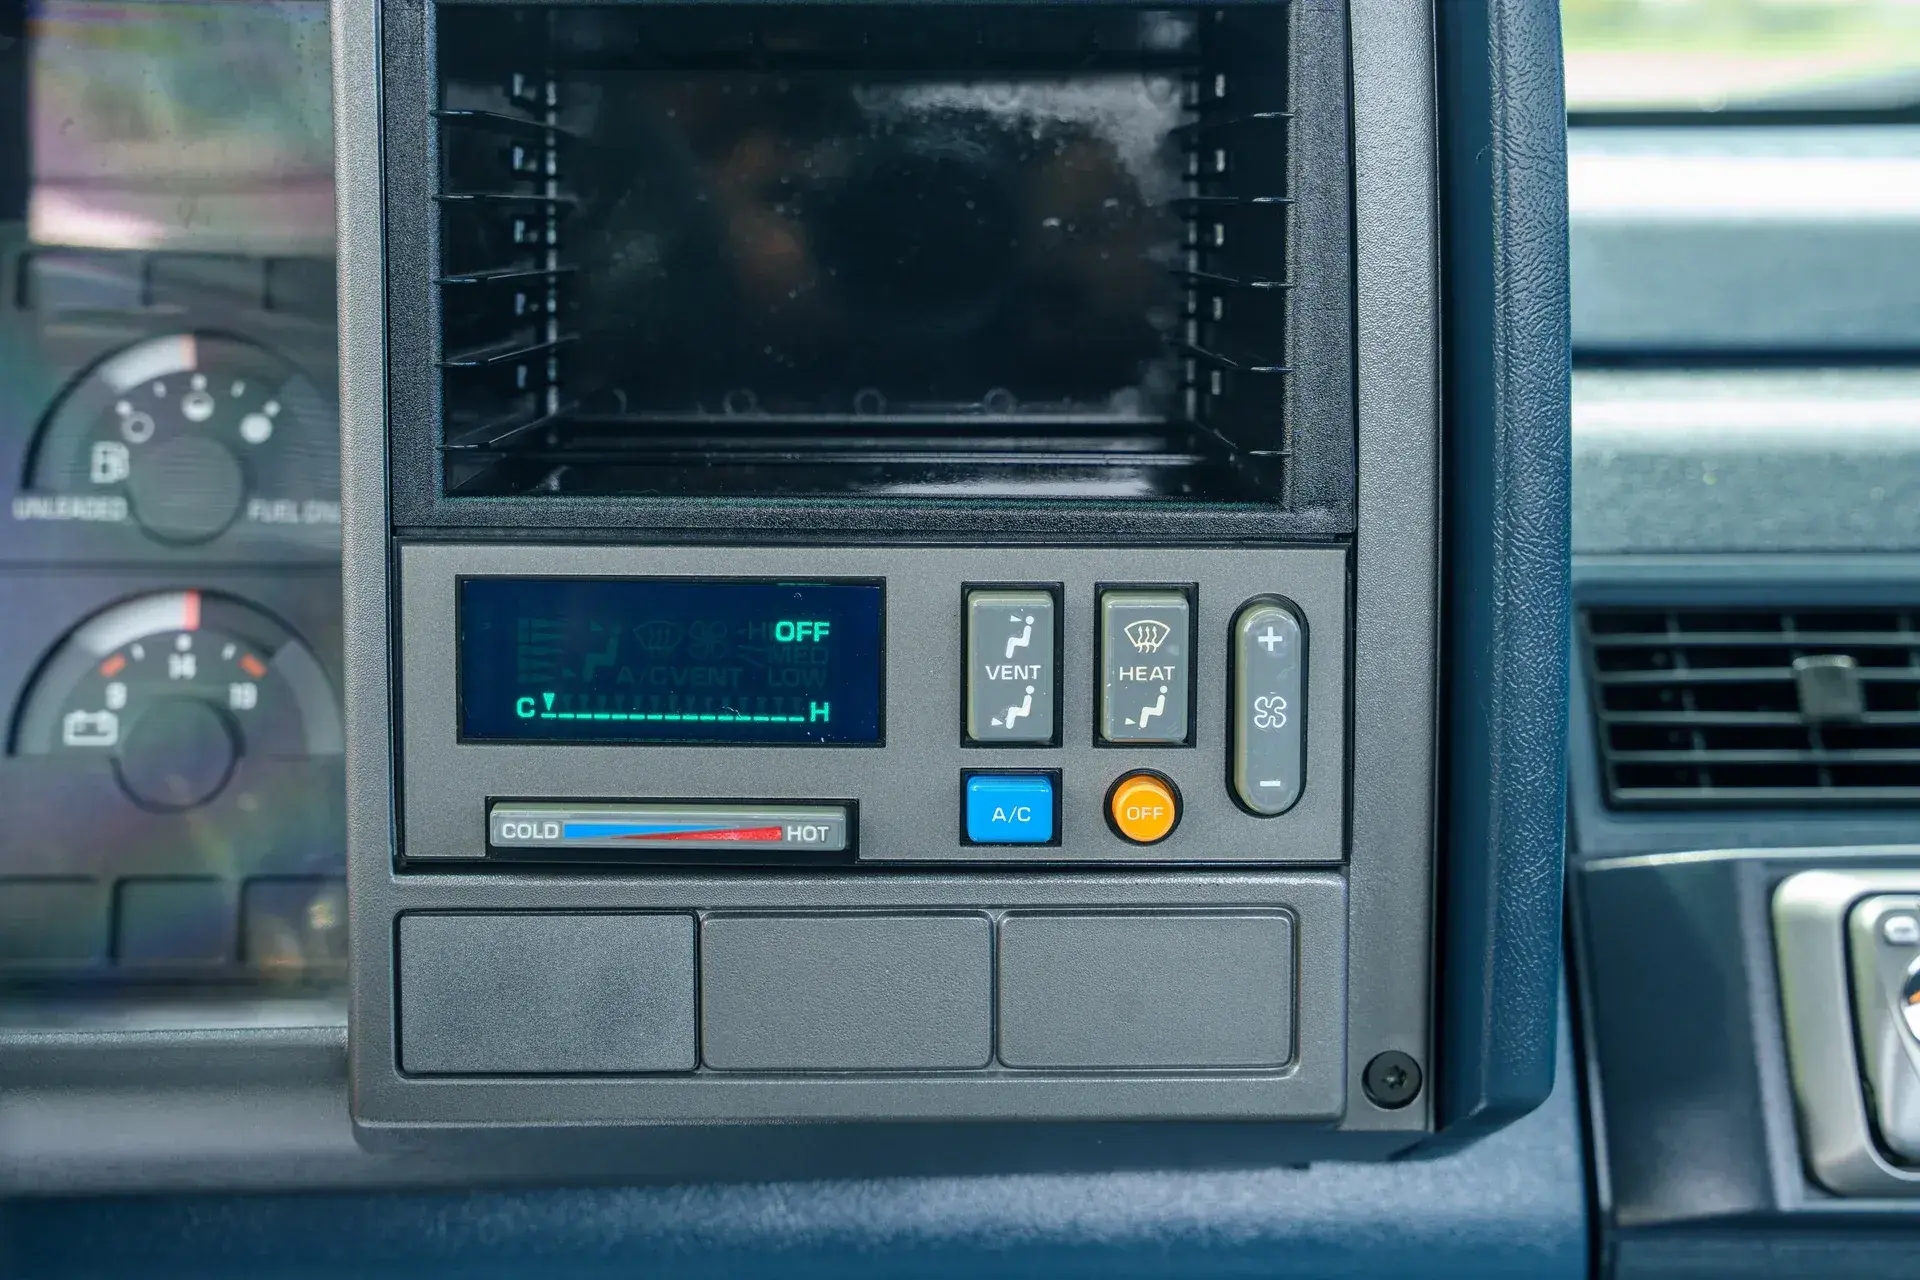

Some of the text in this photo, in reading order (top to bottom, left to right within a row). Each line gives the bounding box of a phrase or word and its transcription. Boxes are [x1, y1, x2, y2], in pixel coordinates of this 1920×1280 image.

[774, 620, 831, 643] OFF
[670, 666, 744, 688] VENT
[768, 668, 829, 688] LOW
[985, 664, 1042, 681] VENT
[1118, 665, 1176, 682] HEAT
[515, 695, 536, 719] C
[808, 701, 831, 723] H
[991, 805, 1032, 823] A/C
[1125, 805, 1164, 821] OFF
[501, 823, 560, 840] COLD
[786, 825, 830, 843] HOT
